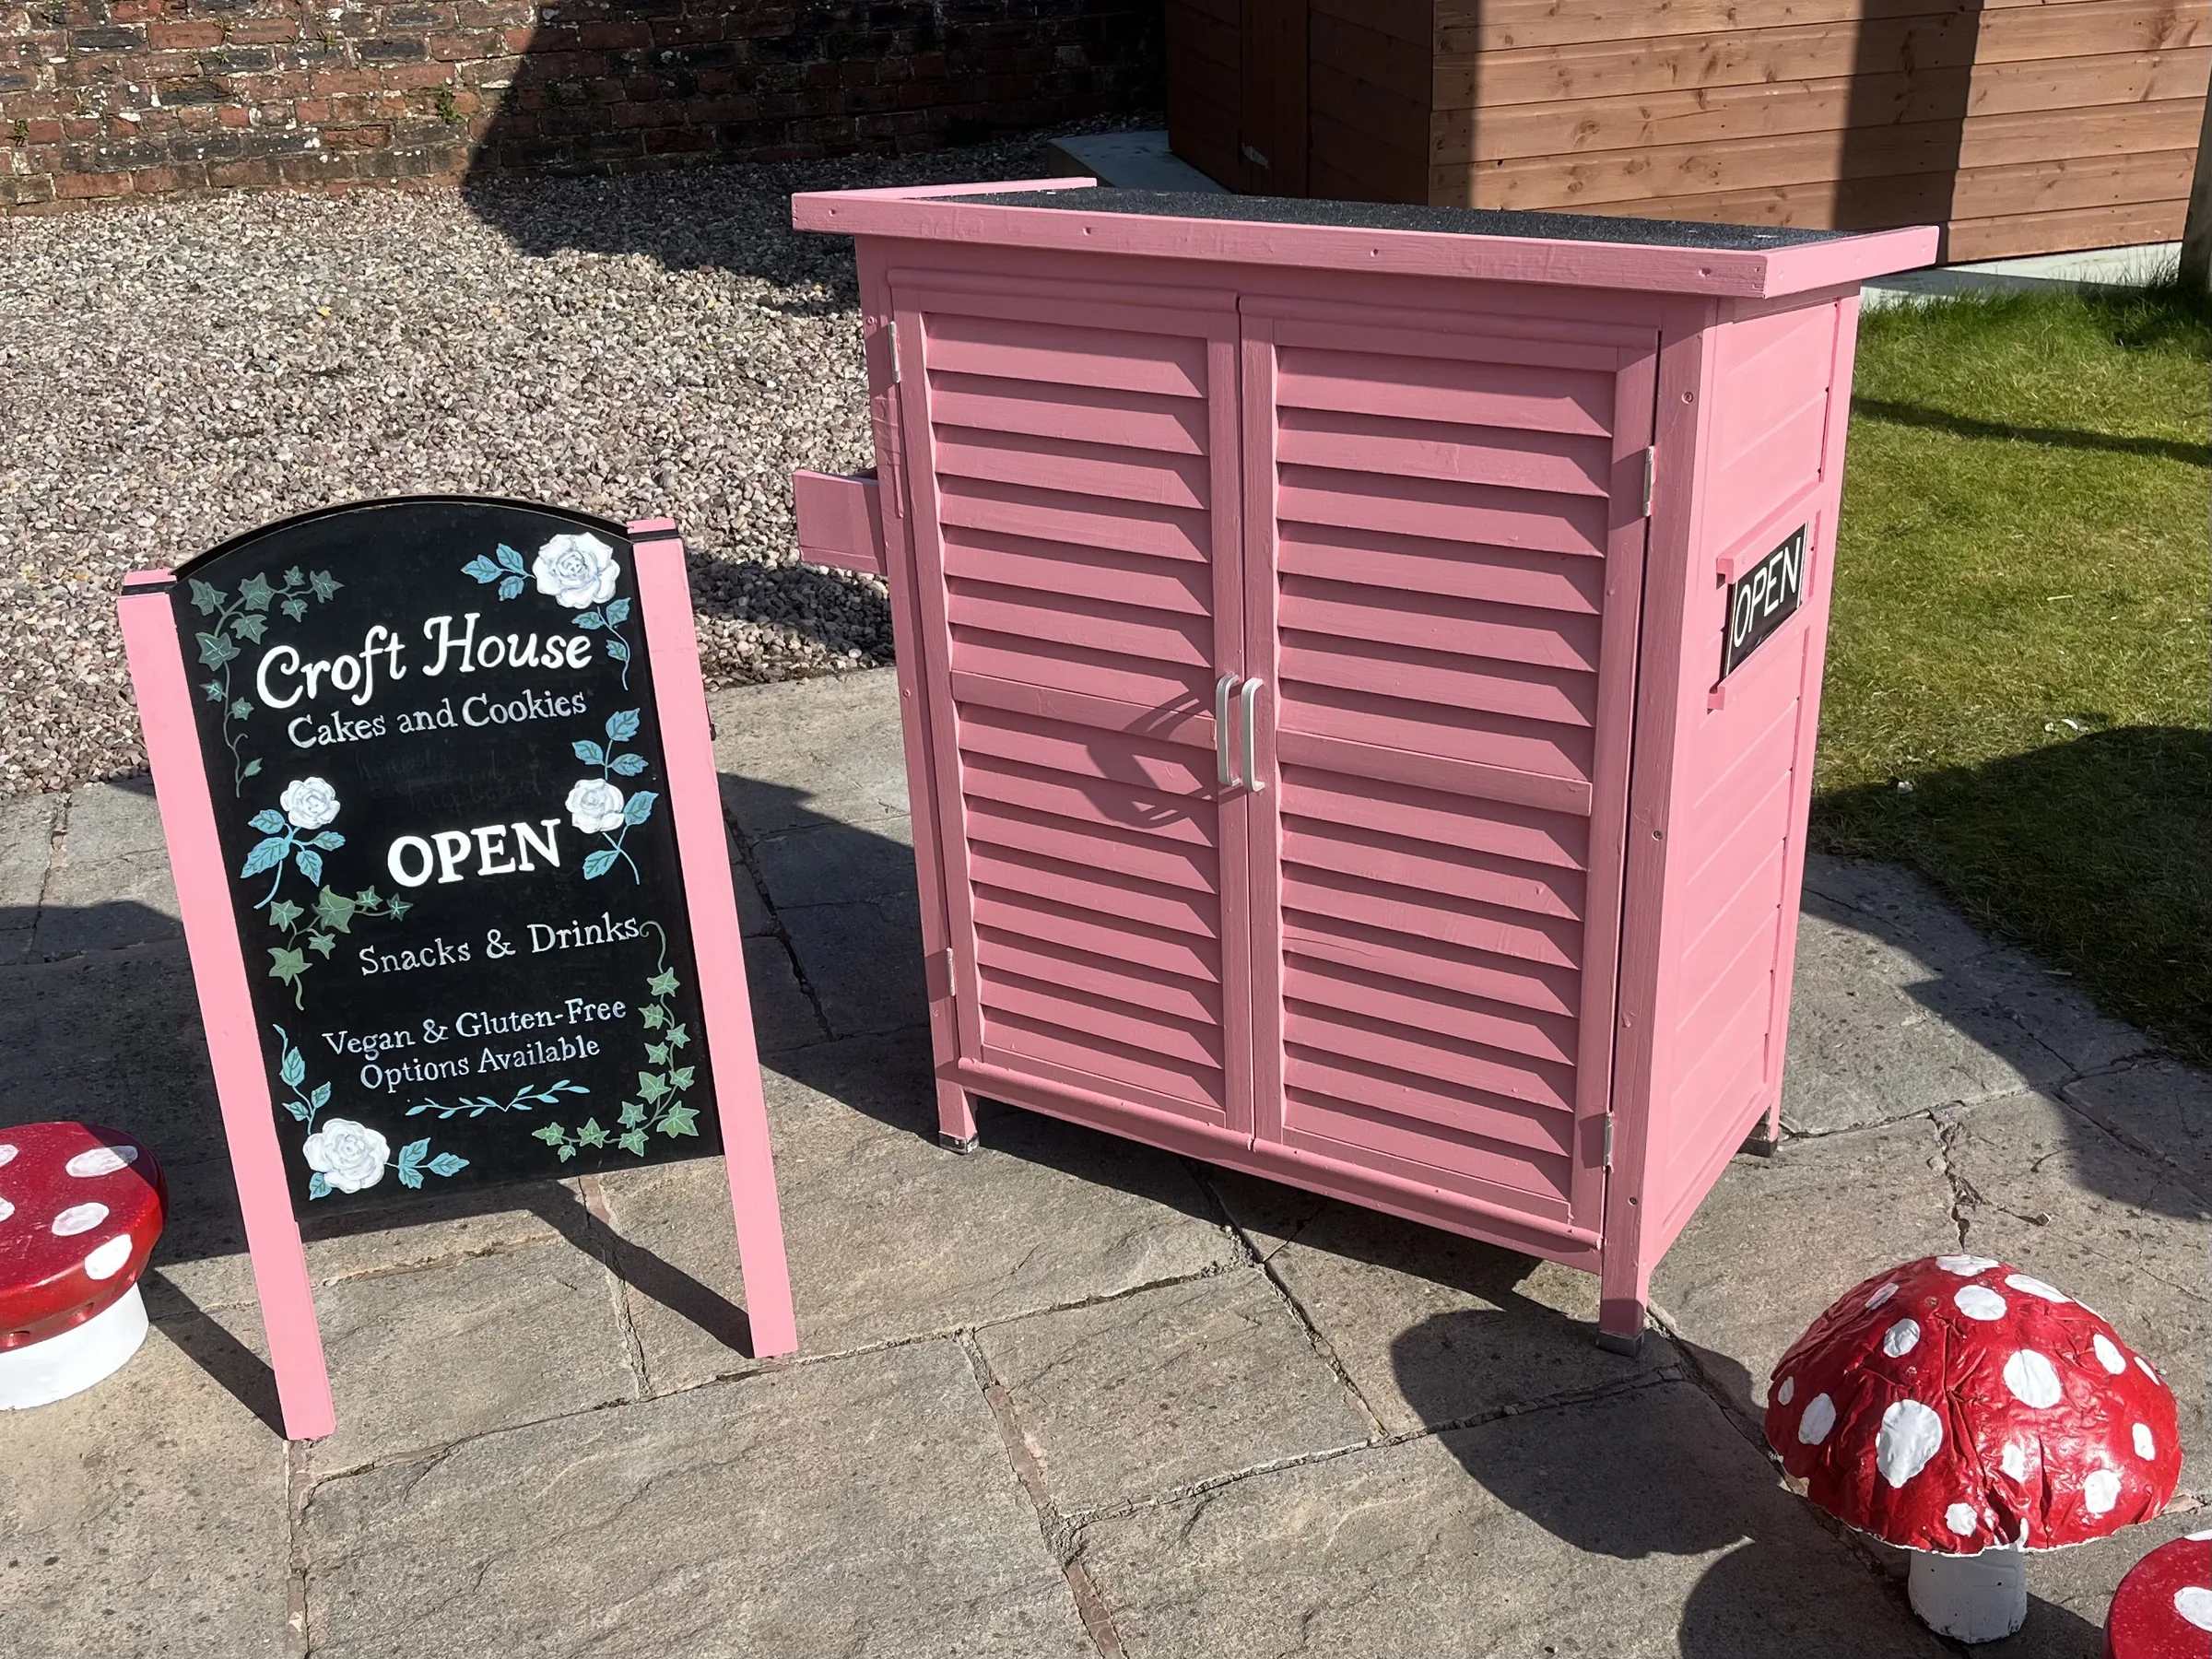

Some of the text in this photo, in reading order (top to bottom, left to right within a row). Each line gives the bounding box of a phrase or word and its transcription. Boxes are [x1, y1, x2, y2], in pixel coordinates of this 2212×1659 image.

[1734, 536, 1801, 647] OPEN
[256, 612, 593, 710] Croft House
[288, 688, 587, 749] Cakes and Cookies
[387, 818, 561, 888] OPEN
[359, 912, 640, 976] Snacks & Drinks
[322, 997, 627, 1060] Vegan & Gluten-Free
[359, 1034, 601, 1094] Options Available
